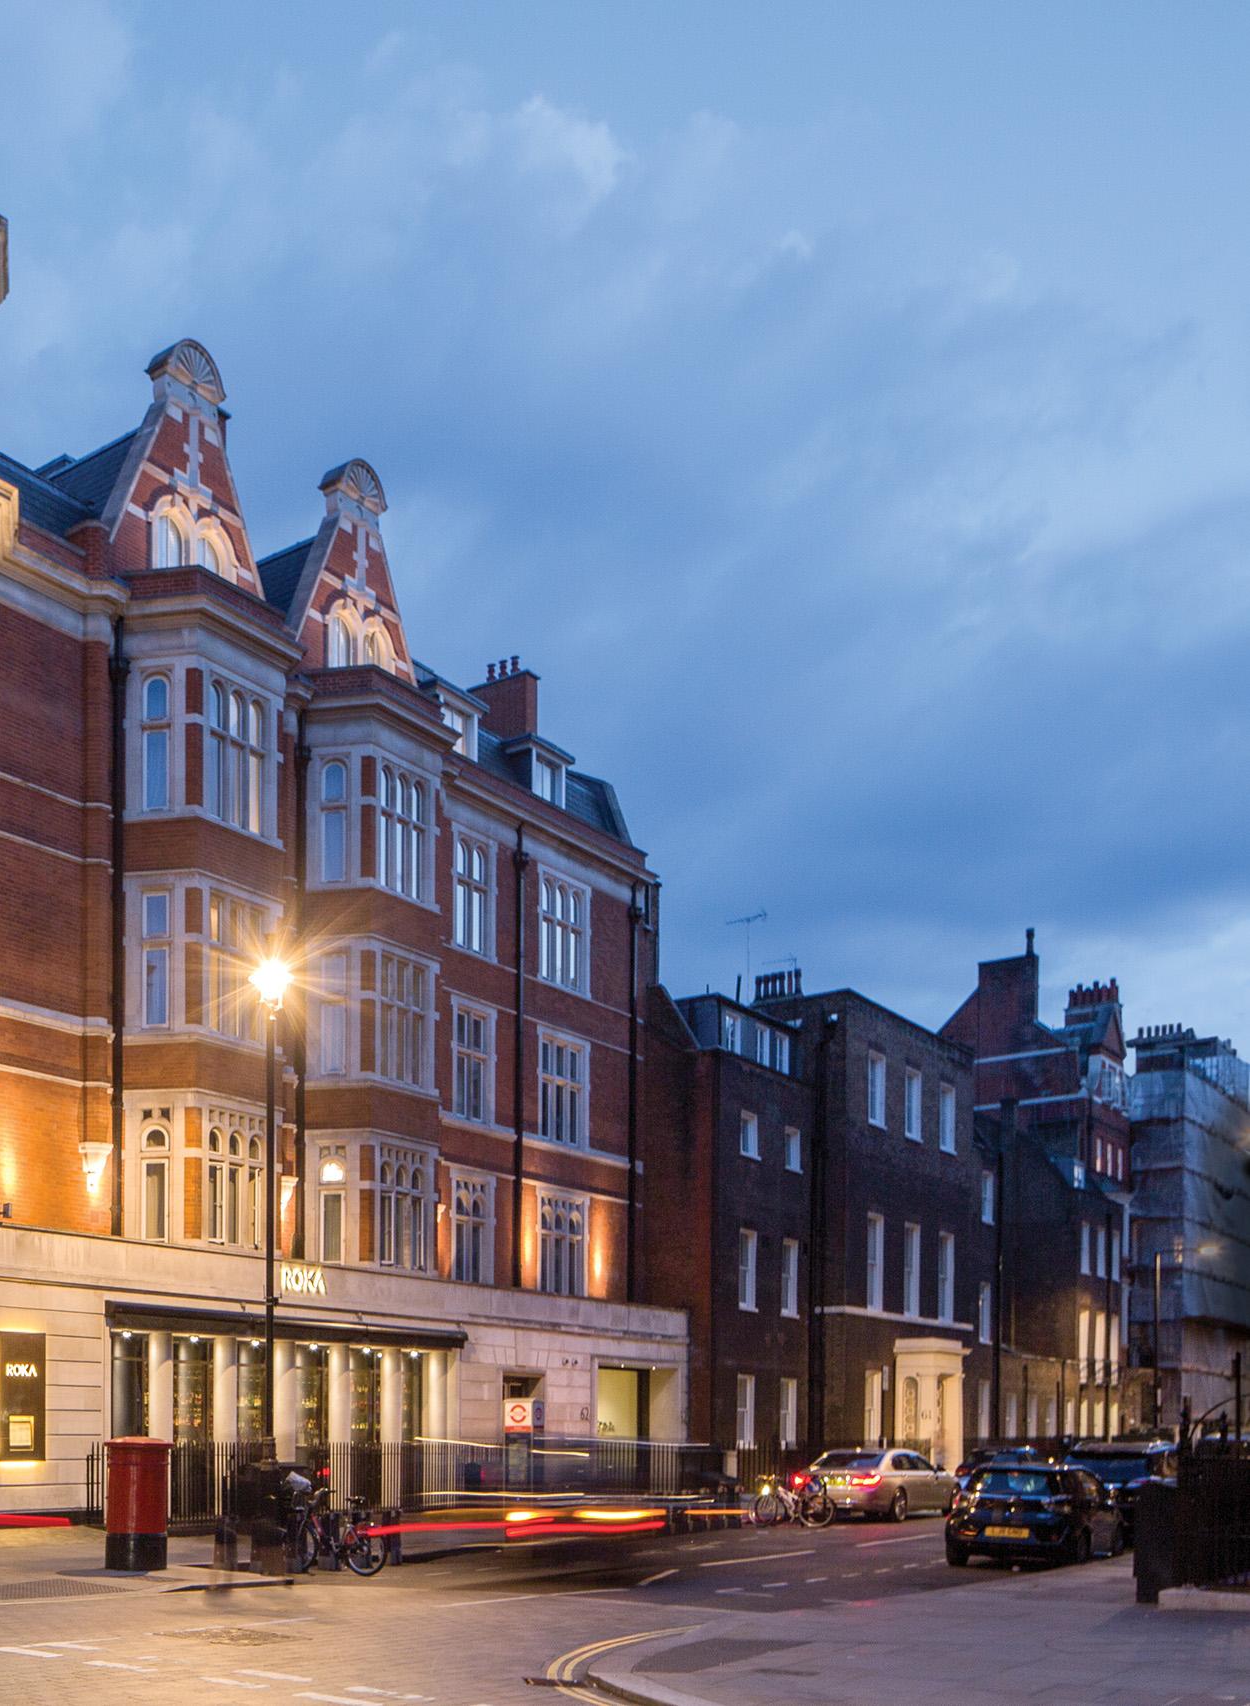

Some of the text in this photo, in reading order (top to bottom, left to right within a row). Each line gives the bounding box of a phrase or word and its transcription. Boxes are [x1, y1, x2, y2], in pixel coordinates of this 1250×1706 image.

[281, 1265, 327, 1296] ROKA
[5, 1363, 38, 1378] ROKA
[580, 1406, 590, 1421] 62
